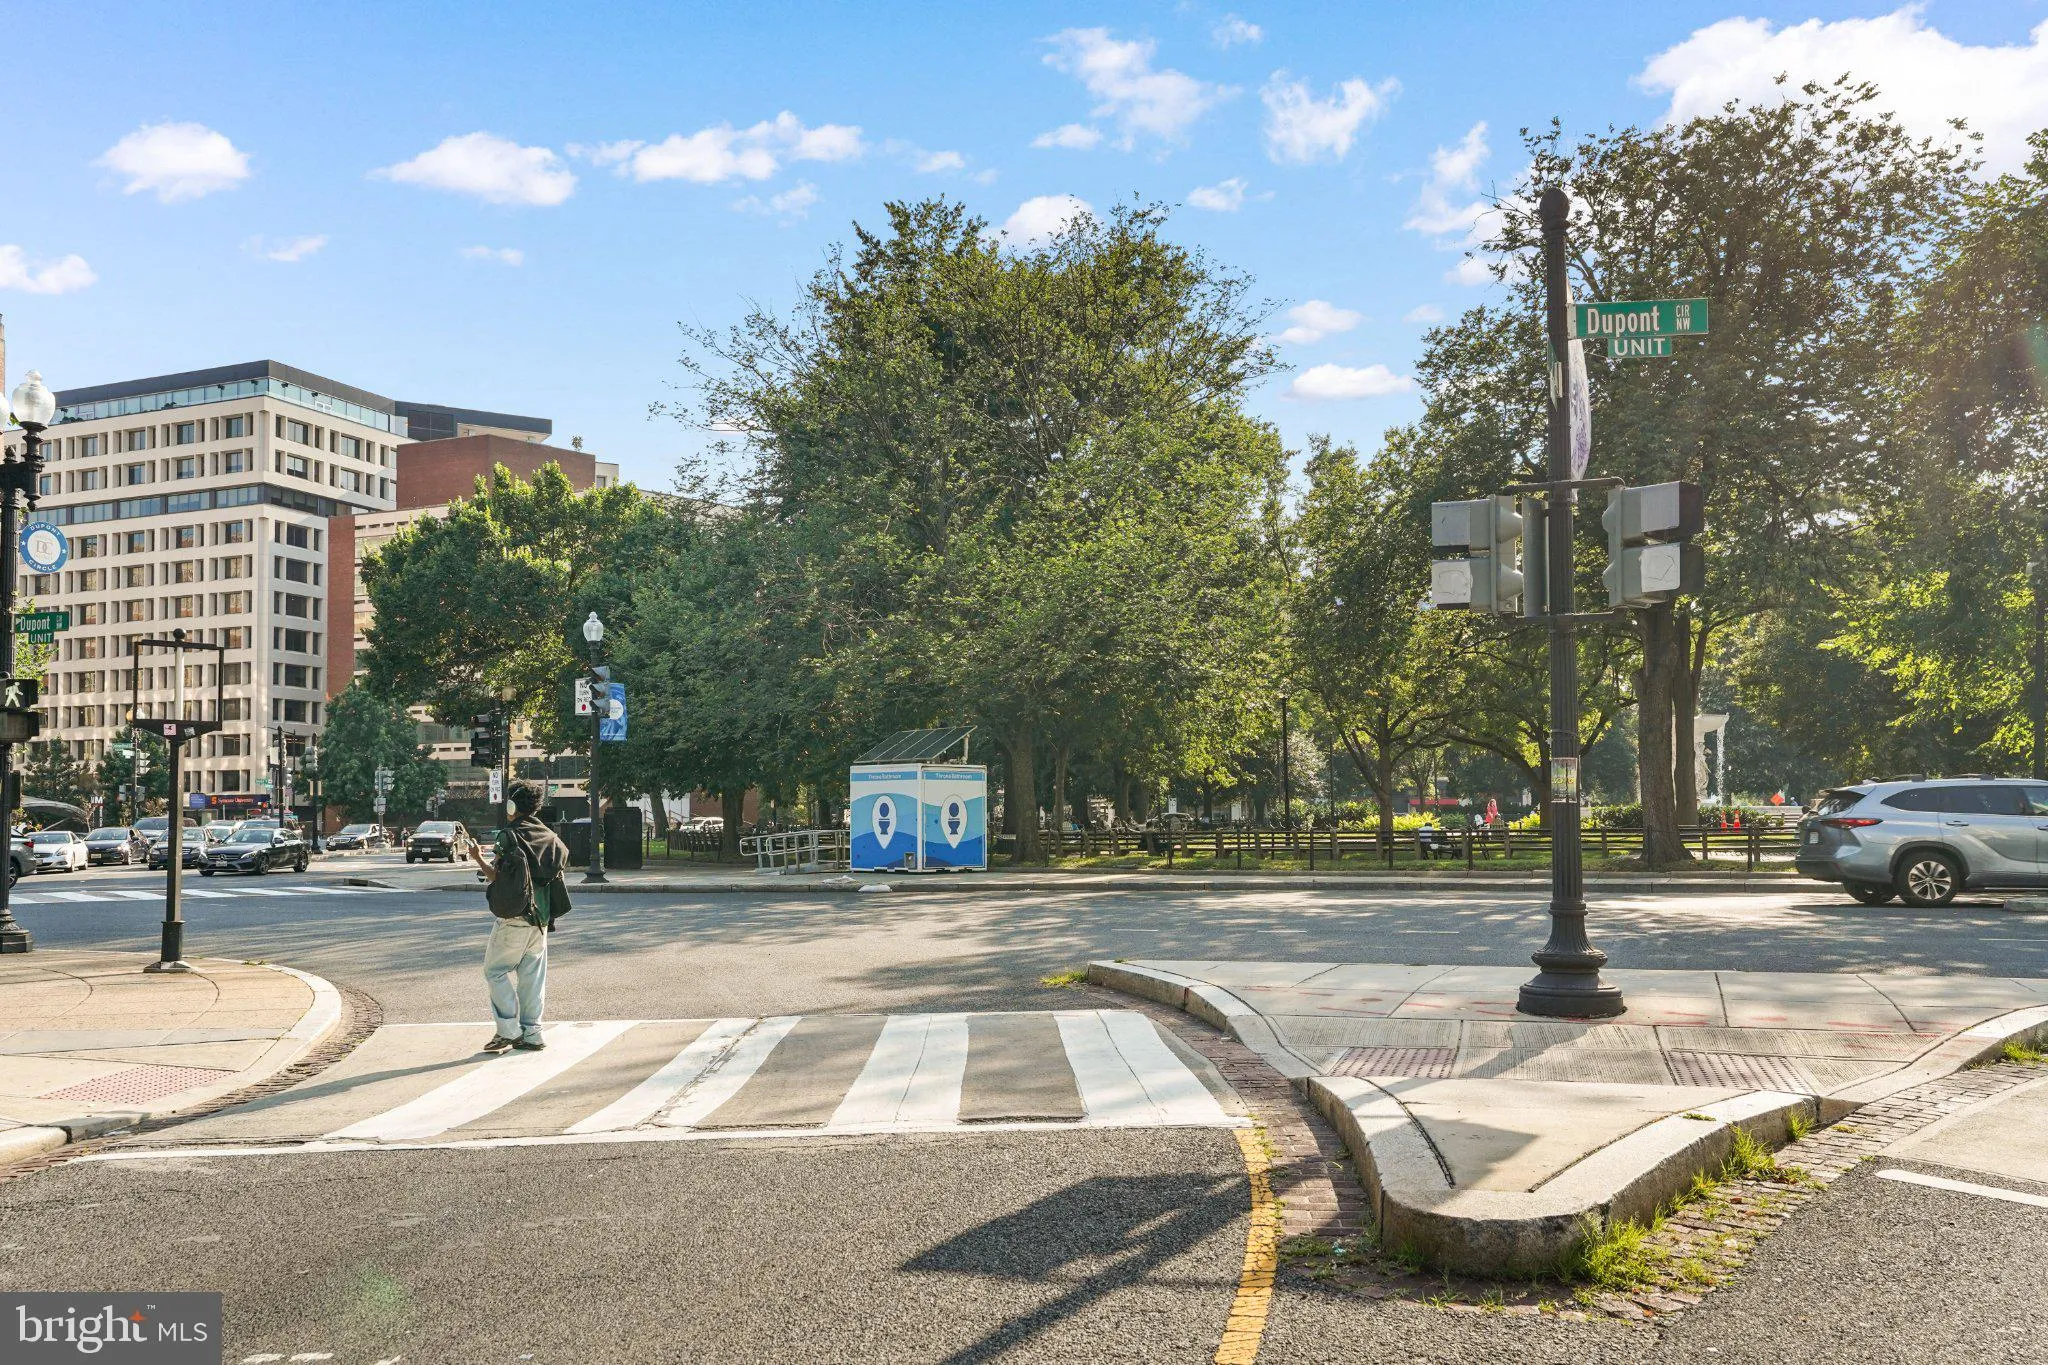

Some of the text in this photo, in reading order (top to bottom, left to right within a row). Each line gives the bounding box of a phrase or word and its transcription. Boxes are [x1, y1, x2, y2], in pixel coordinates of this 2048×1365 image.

[1676, 304, 1690, 317] CIR
[1587, 306, 1660, 337] Dupont
[1676, 318, 1691, 330] NW
[1614, 338, 1665, 356] UNIT
[30, 523, 61, 536] DUPONT
[28, 560, 57, 571] CIRCLE
[20, 616, 50, 631] Dupont
[30, 633, 52, 643] UNIT
